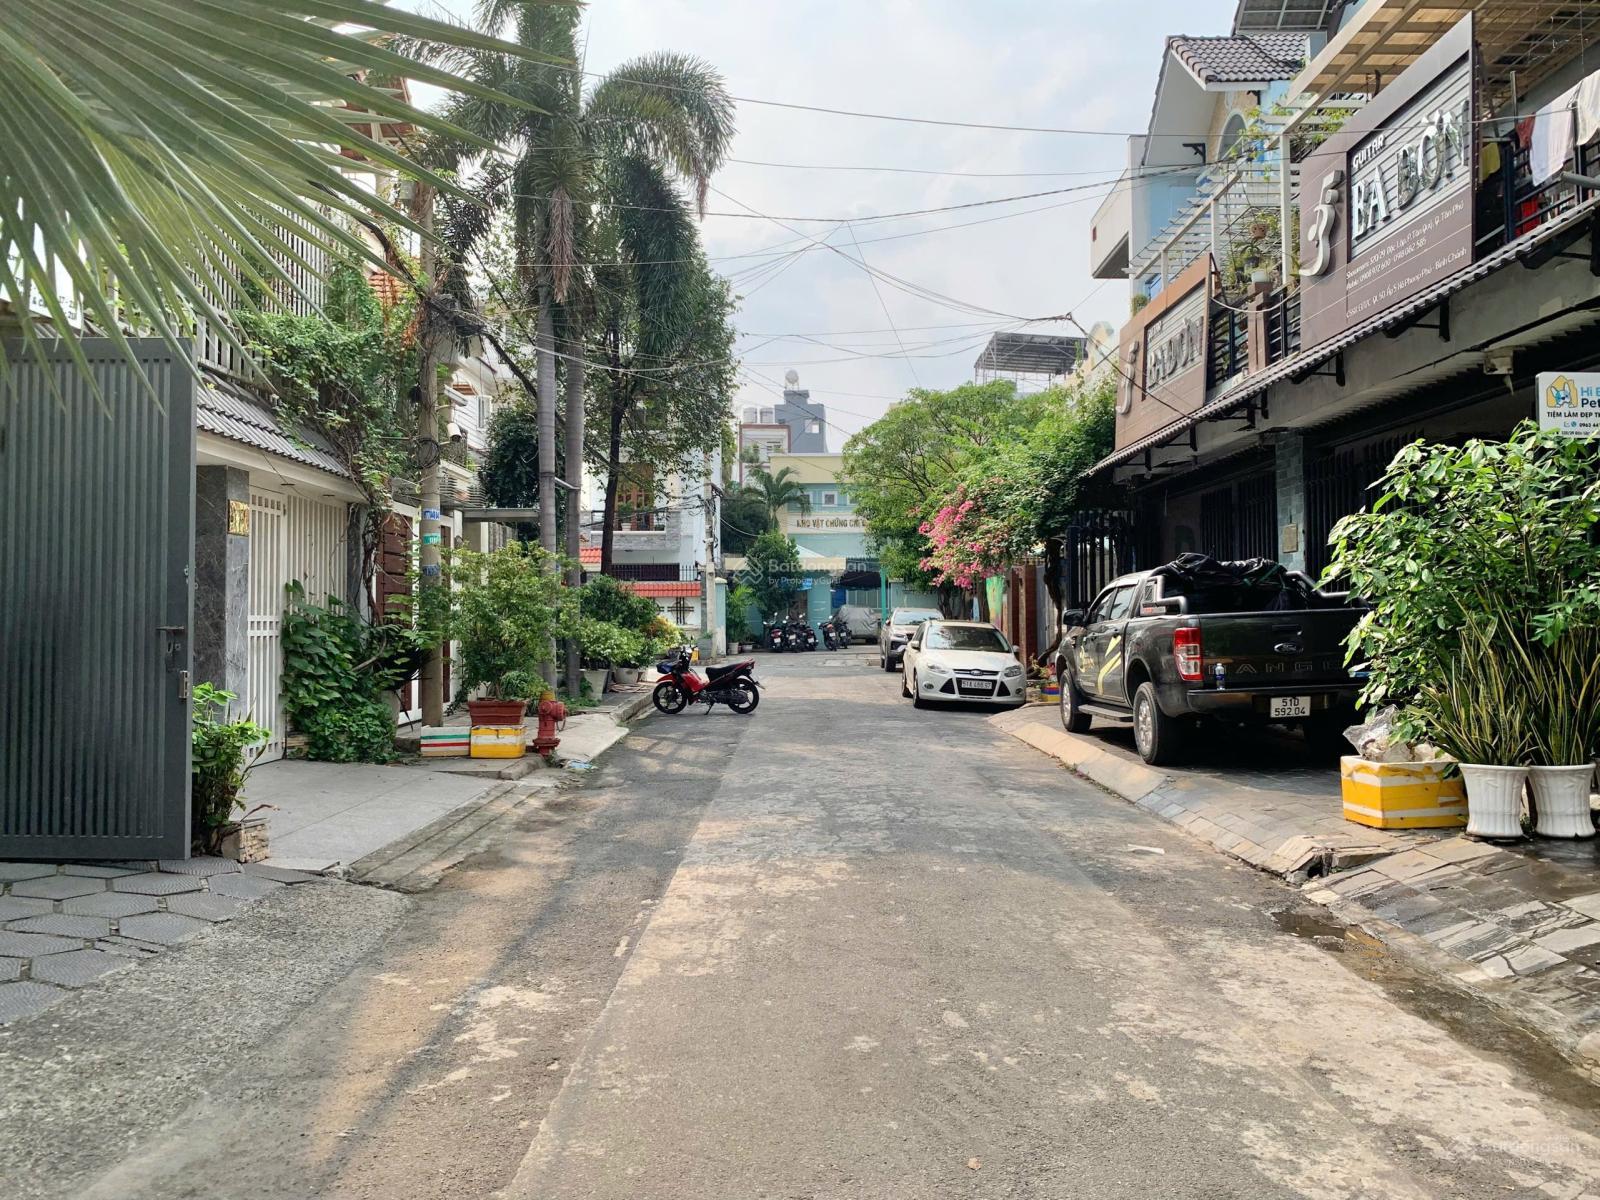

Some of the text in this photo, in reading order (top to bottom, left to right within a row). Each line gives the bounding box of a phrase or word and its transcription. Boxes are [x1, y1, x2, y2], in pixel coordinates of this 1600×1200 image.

[1353, 134, 1385, 168] GUITAR
[1352, 165, 1390, 241] BA
[1282, 697, 1300, 707] 51D
